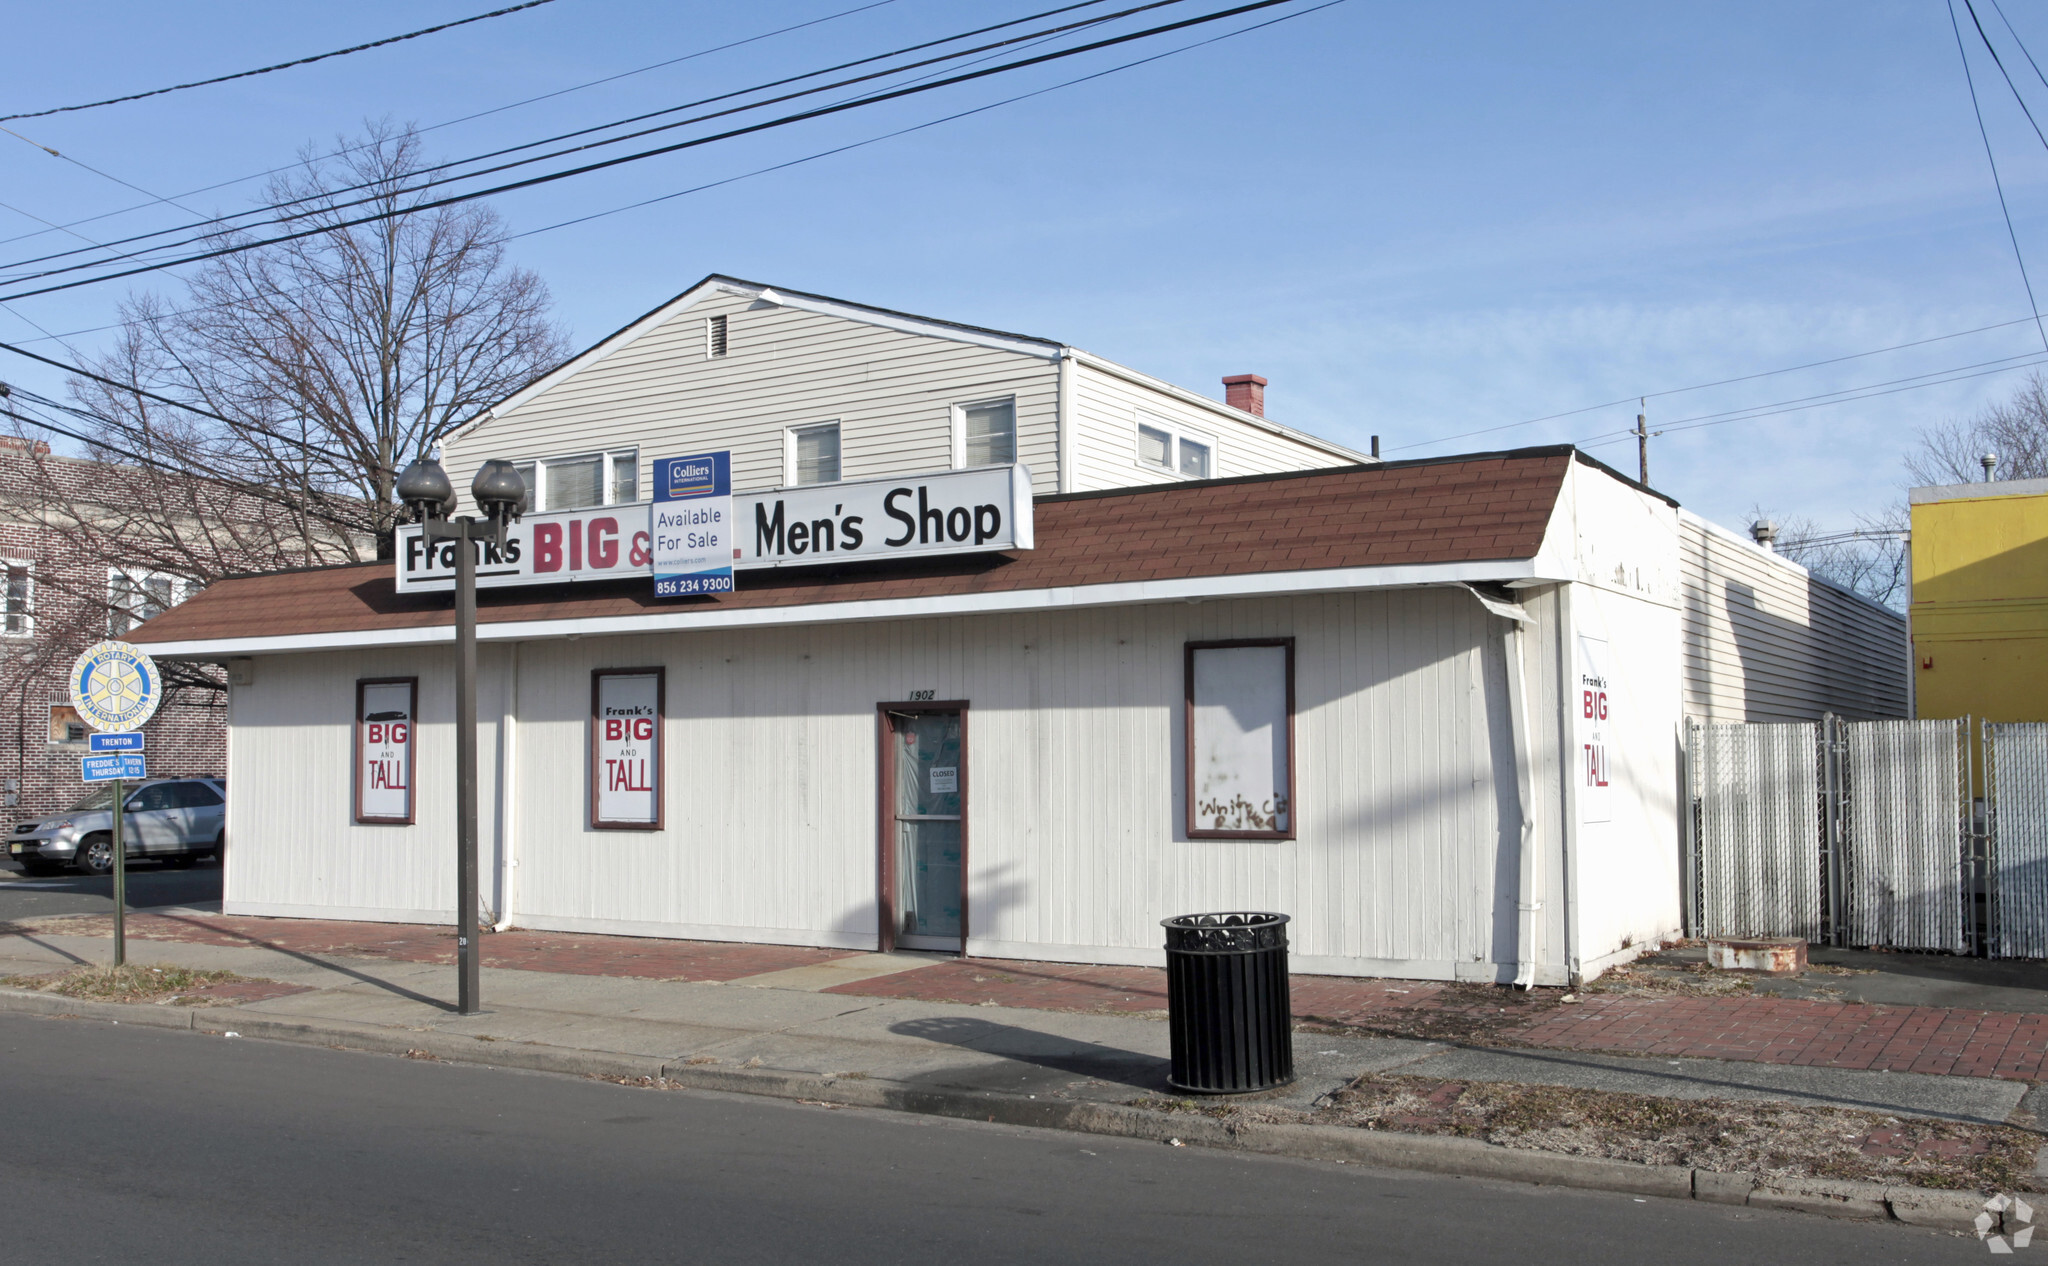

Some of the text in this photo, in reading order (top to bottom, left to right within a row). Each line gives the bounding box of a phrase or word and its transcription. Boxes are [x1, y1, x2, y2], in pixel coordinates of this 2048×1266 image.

[673, 464, 708, 477] Colliers
[674, 476, 707, 484] INTERNATIONAL
[657, 507, 720, 527] Available
[533, 517, 619, 574] BIG
[629, 530, 653, 567] &
[755, 500, 863, 557] Men's
[883, 485, 1001, 547] Shop
[658, 532, 717, 550] For Sale
[657, 577, 730, 593] 856 234 9300
[97, 651, 133, 661] ROTARY
[1582, 674, 1606, 687] Frank's
[909, 690, 934, 700] 1902
[83, 695, 147, 722] INTERNATIONAL
[606, 705, 652, 715] Frank's
[1583, 690, 1607, 720] BIG
[369, 723, 407, 743] BIG
[606, 718, 652, 740] BIG
[101, 738, 132, 746] TRENTON
[1592, 732, 1600, 741] AND
[620, 749, 636, 757] AND
[124, 758, 141, 766] TAVERN
[1584, 744, 1608, 786] TALL
[91, 767, 124, 776] THURSDAY
[368, 760, 406, 789] TALL
[606, 759, 651, 791] TALL
[932, 770, 954, 778] CLOSED
